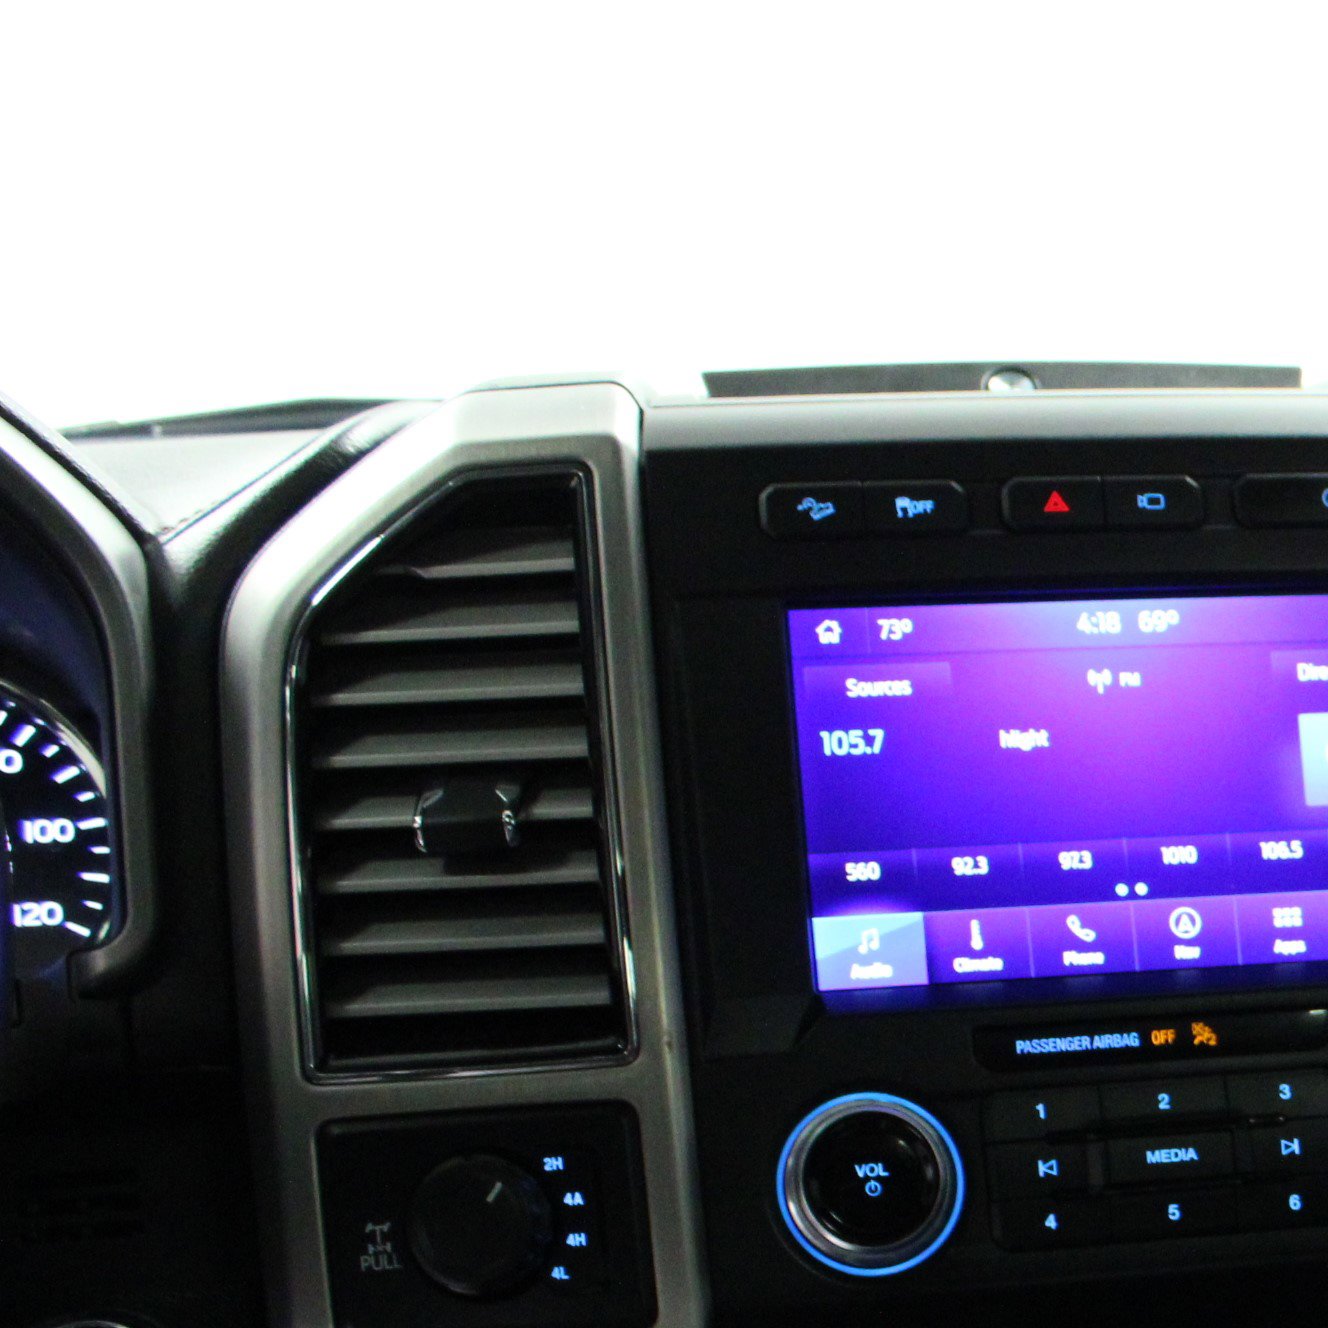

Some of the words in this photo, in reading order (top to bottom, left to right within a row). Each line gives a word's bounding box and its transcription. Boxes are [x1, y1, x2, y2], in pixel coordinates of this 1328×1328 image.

[845, 677, 913, 698] Sources
[819, 728, 885, 756] 105.7
[20, 817, 76, 844] 100
[1160, 845, 1199, 865] 1010
[845, 861, 882, 882] 560
[951, 855, 990, 876] 92.3
[11, 900, 65, 928] 120
[1015, 1035, 1091, 1054] PASSENGER
[1092, 1032, 1141, 1049] AIRBAG
[1151, 1029, 1175, 1046] OFF
[1279, 1083, 1292, 1100] 3
[1157, 1093, 1171, 1110] 2
[1035, 1103, 1047, 1119] 1
[543, 1156, 565, 1172] 2H
[1146, 1147, 1199, 1164] MEDIA
[854, 1163, 890, 1178] VOL
[563, 1191, 585, 1206] 4A
[1288, 1194, 1303, 1211] 6
[1167, 1203, 1182, 1221] 5
[1044, 1213, 1059, 1230] 4
[565, 1232, 588, 1247] 4H
[359, 1253, 402, 1272] PULL
[551, 1266, 570, 1280] 4L
